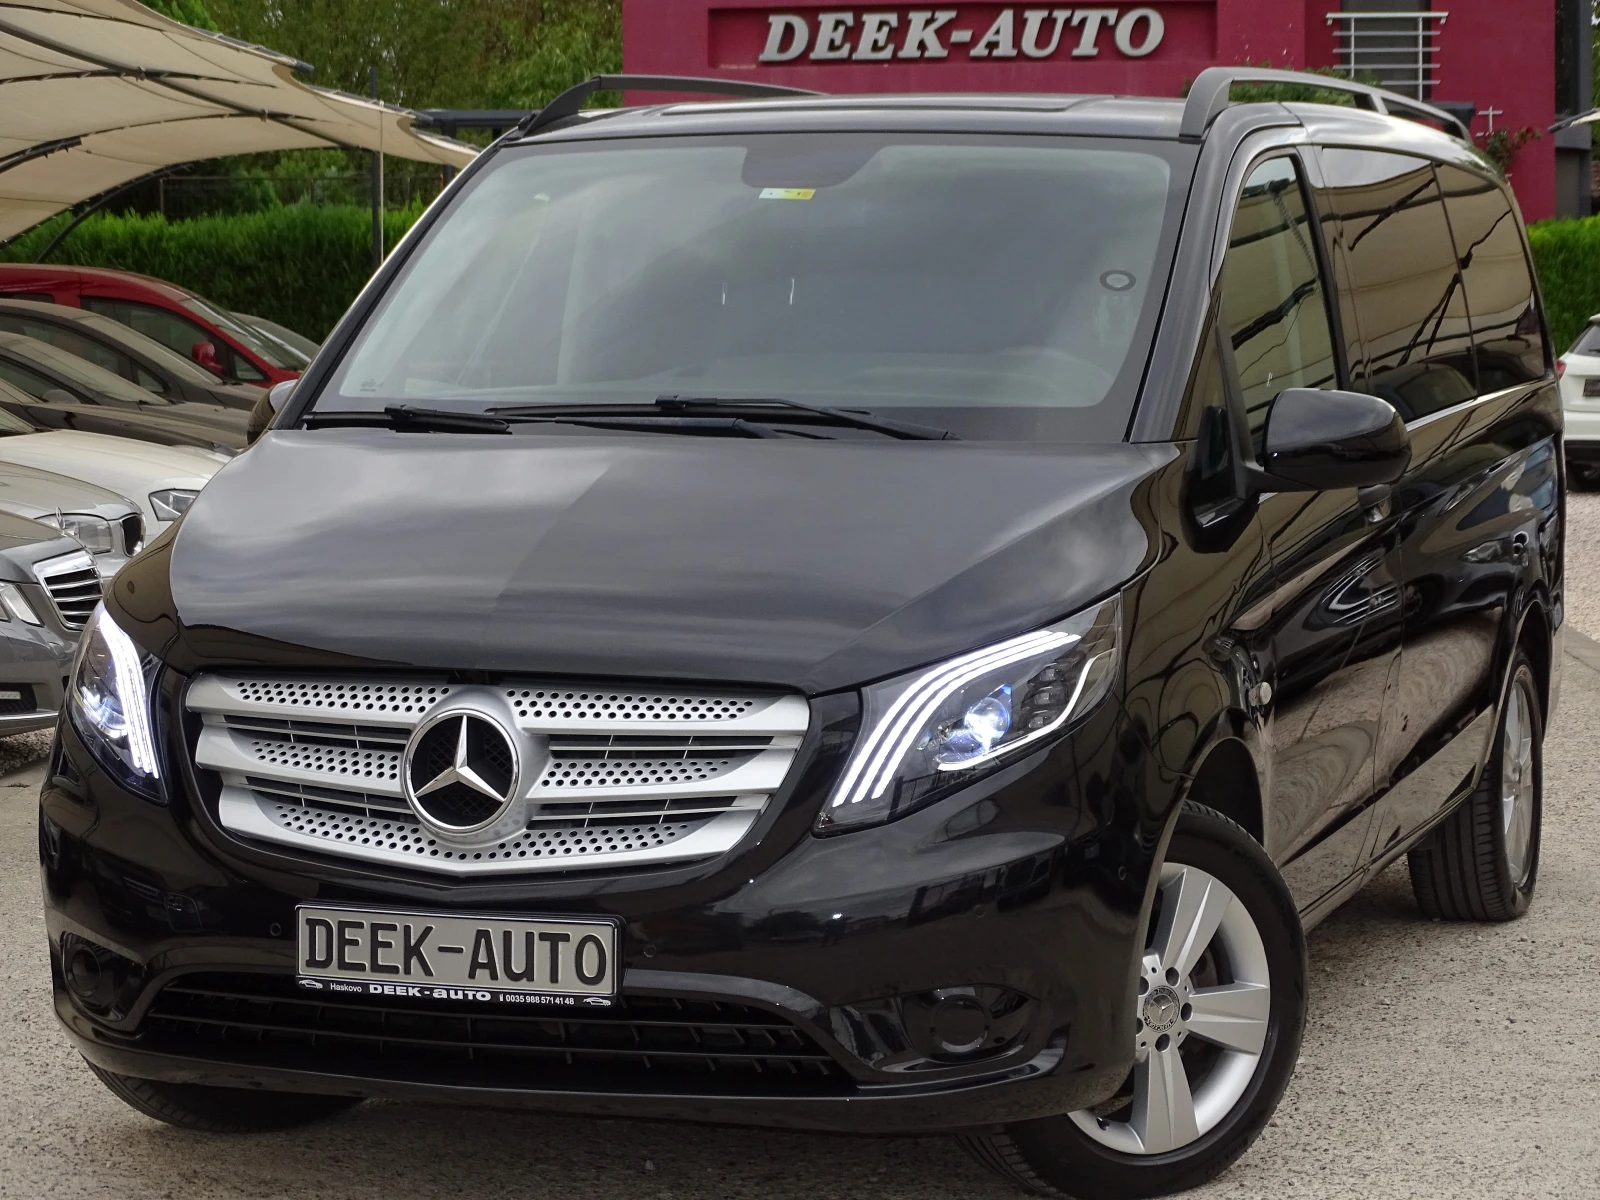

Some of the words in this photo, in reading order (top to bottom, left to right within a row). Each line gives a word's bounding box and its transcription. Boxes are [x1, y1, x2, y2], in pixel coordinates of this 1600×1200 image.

[759, 8, 1165, 62] DEEK-AUTO
[305, 918, 607, 986] DEEK-AUTO
[330, 982, 363, 993] Haskovo
